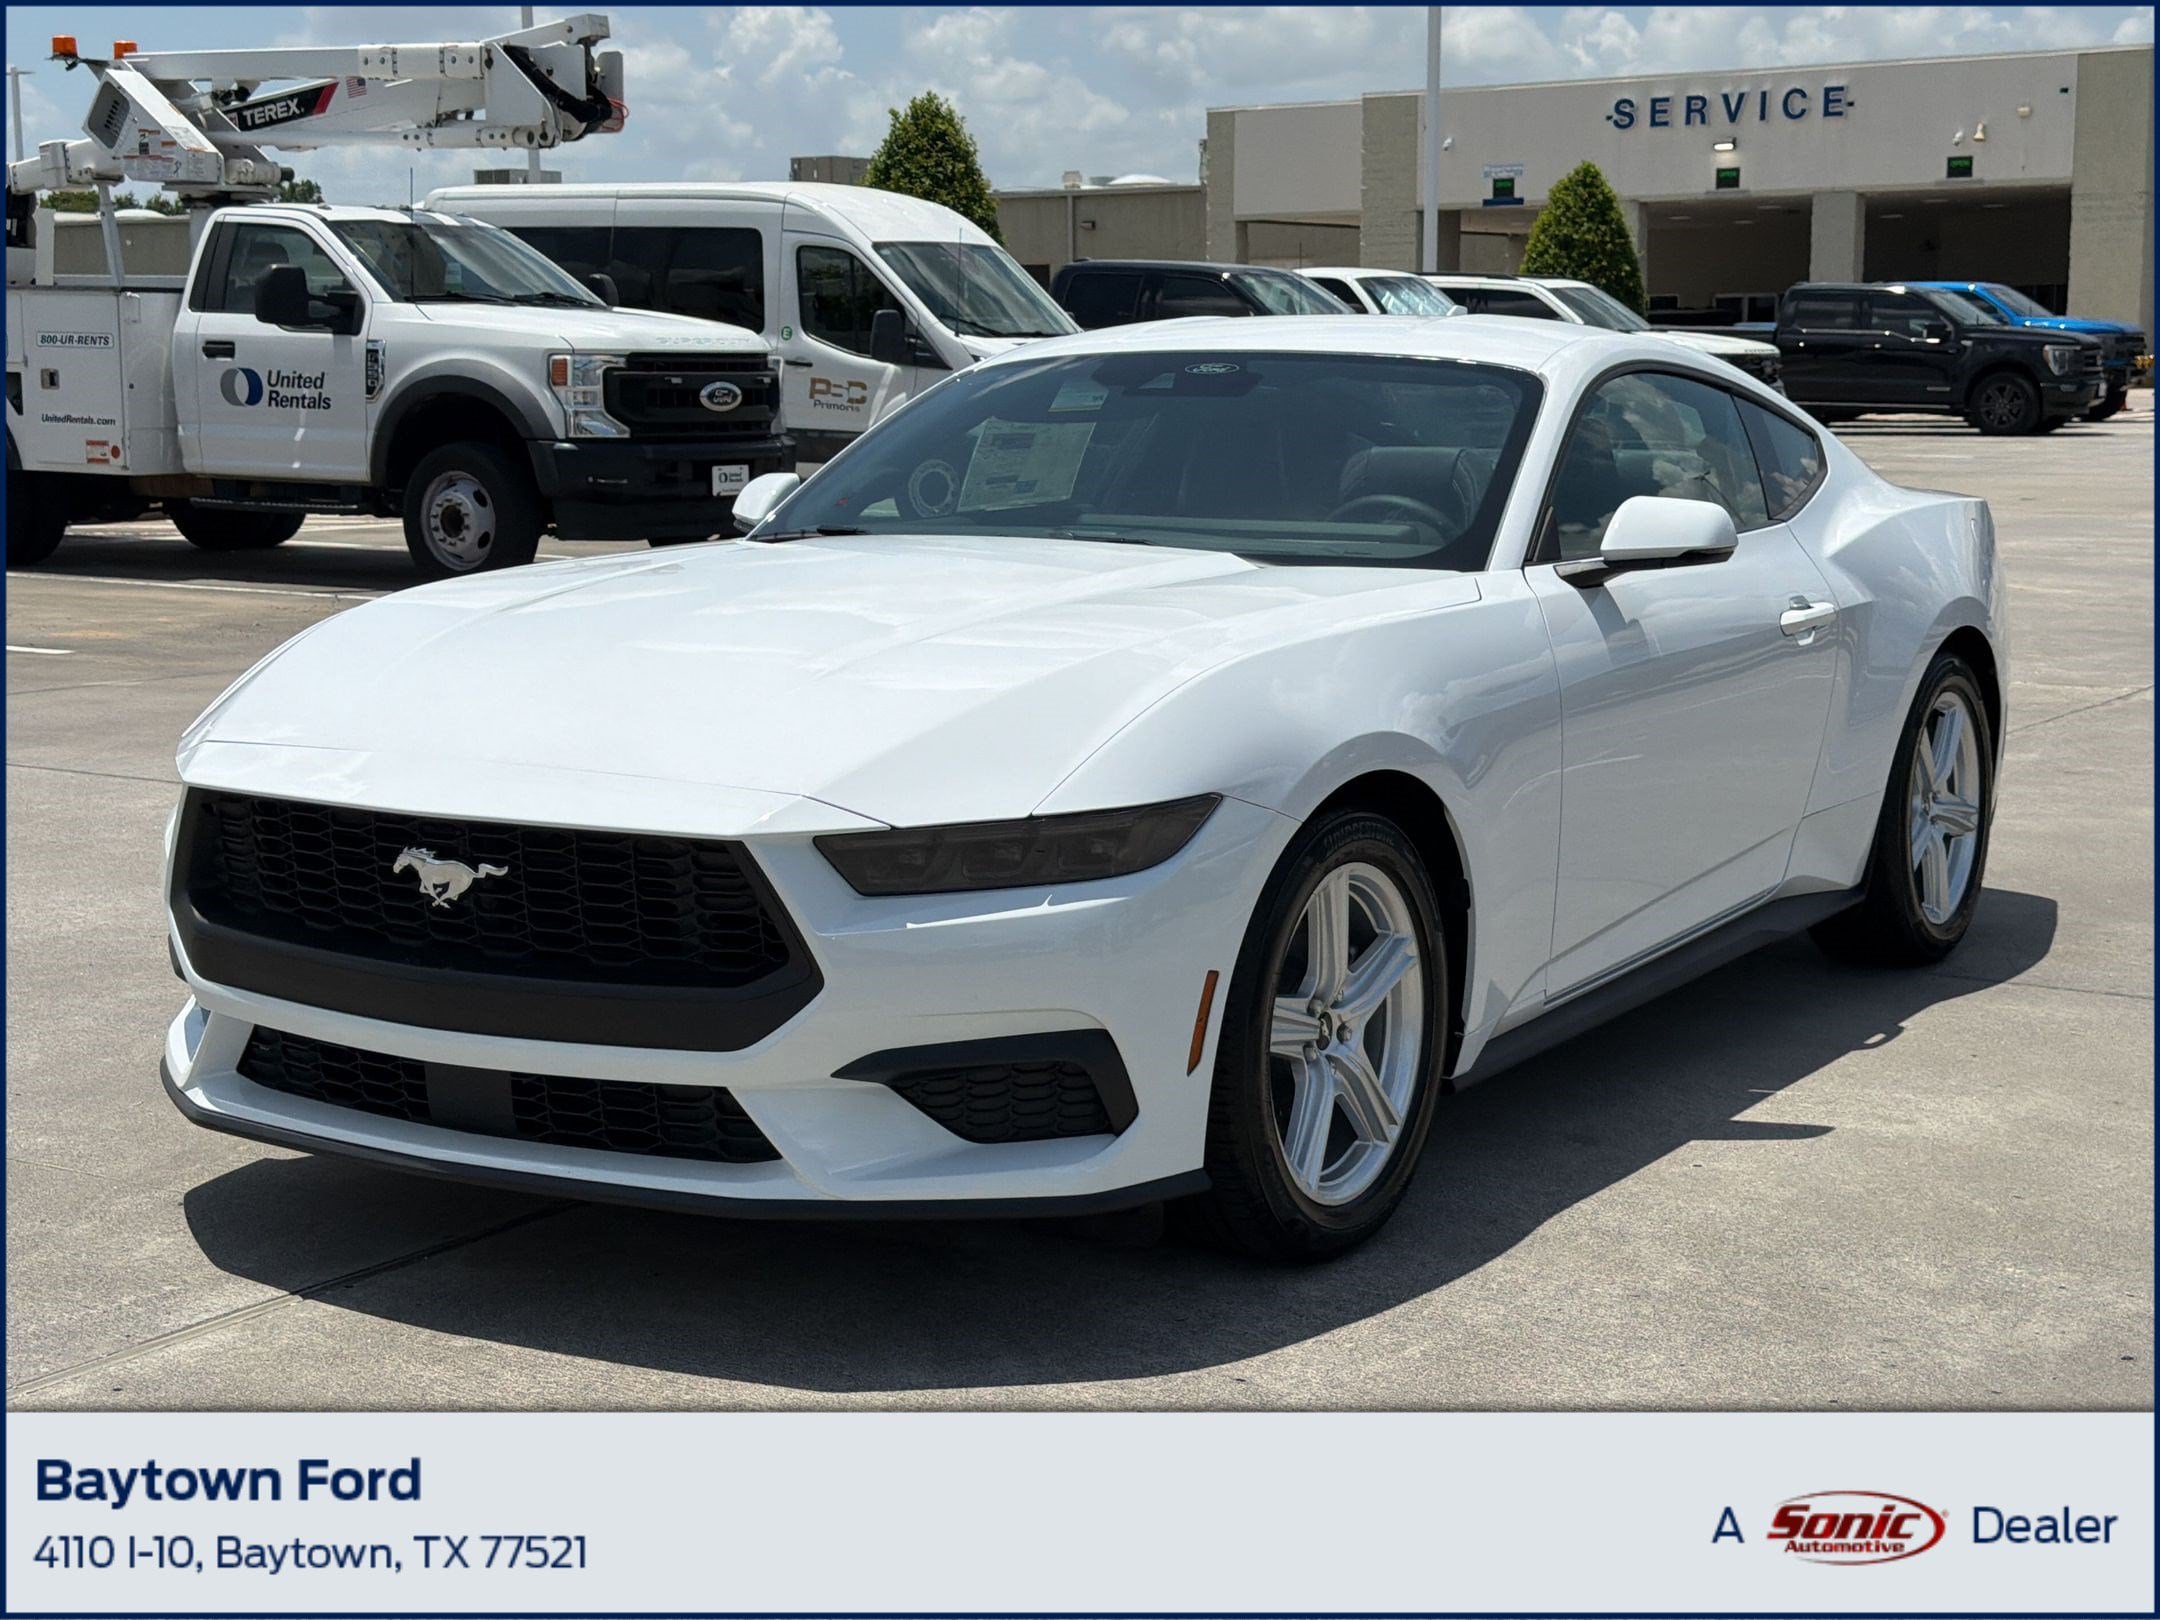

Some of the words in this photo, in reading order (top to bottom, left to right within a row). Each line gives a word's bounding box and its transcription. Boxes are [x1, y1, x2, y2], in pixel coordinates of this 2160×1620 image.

[242, 98, 300, 127] TEREX
[1612, 86, 1846, 130] SERVICE
[40, 334, 110, 347] 800-UR-RENTS
[267, 369, 325, 390] United
[268, 389, 332, 410] Rentals
[41, 413, 117, 426] UnitedRentals.com
